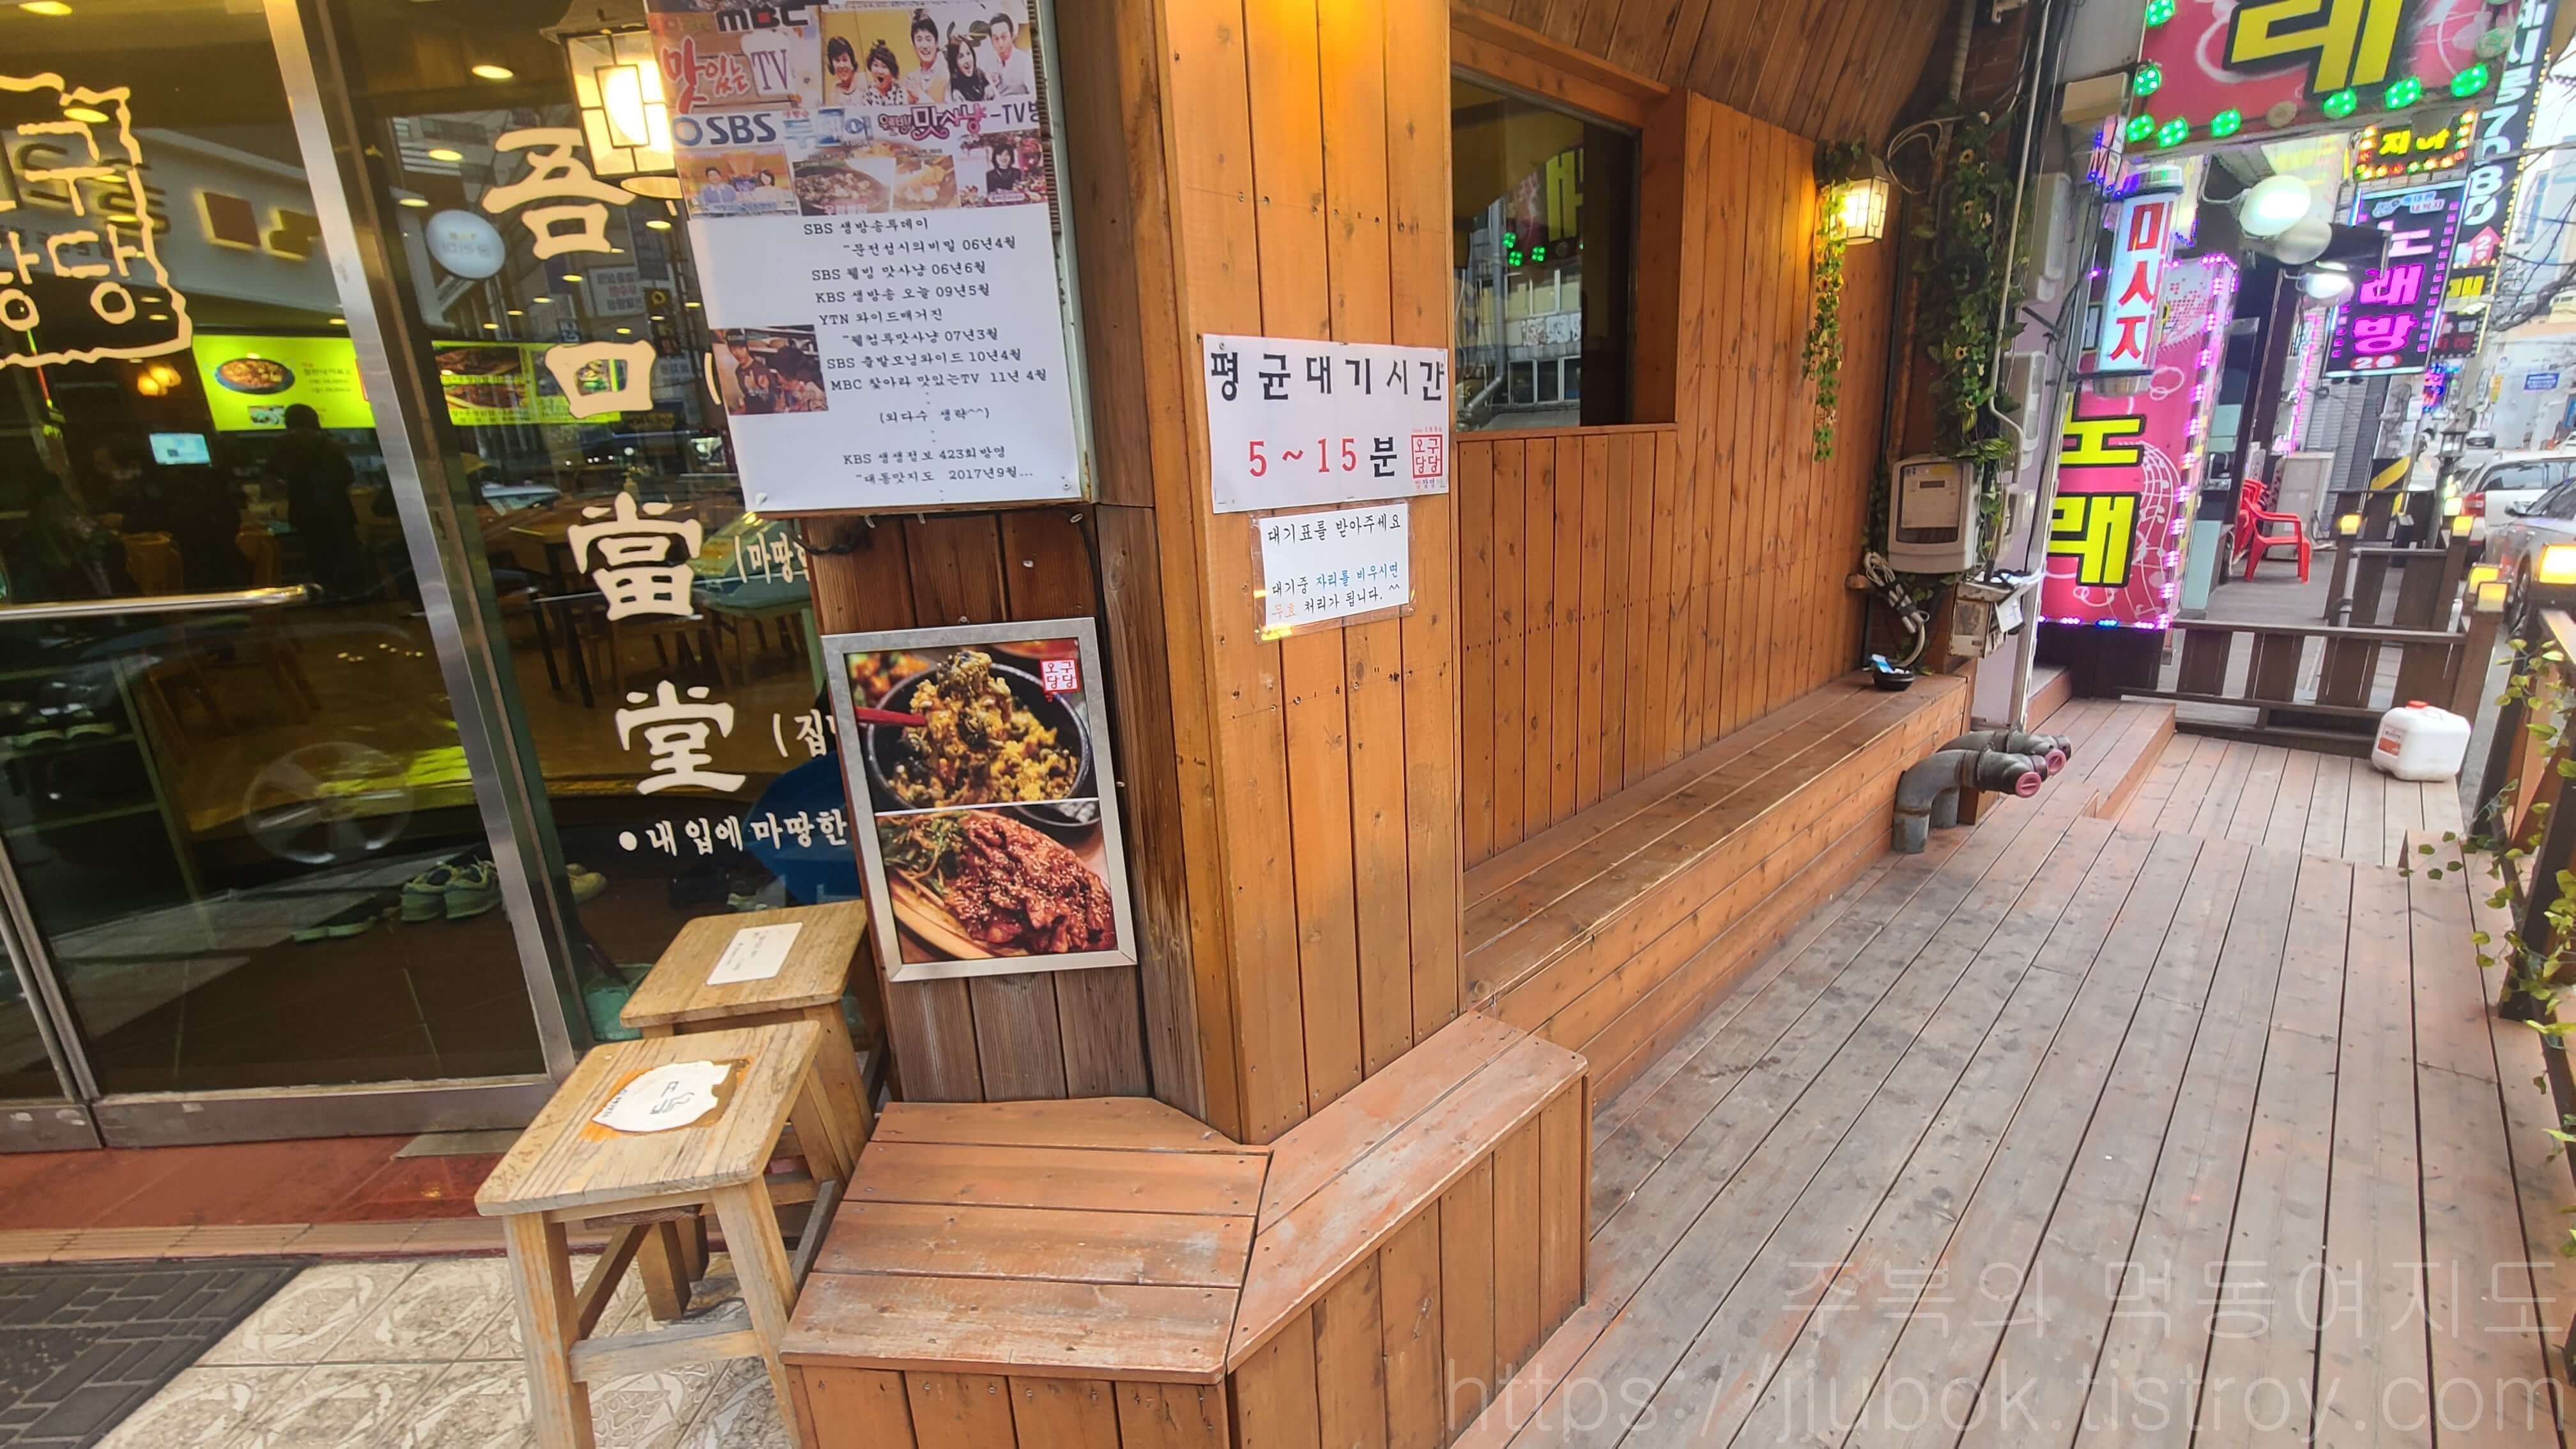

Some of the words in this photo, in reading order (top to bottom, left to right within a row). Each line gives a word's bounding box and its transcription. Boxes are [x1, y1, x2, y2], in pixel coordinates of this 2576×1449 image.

[715, 5, 809, 31] MBC
[663, 37, 749, 114] 맛있는
[751, 49, 788, 90] TV
[706, 113, 777, 145] SBS
[910, 102, 987, 141] 맛사냥
[803, 223, 833, 235] SBS
[840, 217, 928, 234] 생방송투데이
[962, 235, 1015, 250] 06년4월
[811, 269, 841, 281] SBS
[847, 266, 873, 280] 웰빙
[882, 263, 926, 278] 맛사냥
[931, 261, 985, 275] 06년6월
[815, 291, 845, 303] KBS
[852, 288, 894, 303] 생방송
[901, 286, 930, 299] 오늘
[936, 283, 990, 298] 09년5월
[818, 314, 848, 325] YTN
[856, 308, 942, 324] 와이드매거진
[944, 327, 997, 342] 07년3월
[827, 358, 855, 369] SBS
[861, 352, 964, 368] 출발모닝와이드
[969, 348, 1021, 362] 10년4월
[830, 379, 862, 391] MBC
[869, 376, 912, 390] 찾아라
[916, 373, 979, 387] 맛있는TV
[990, 370, 1019, 383] 11년
[1026, 368, 1046, 381] 4월
[1211, 351, 1445, 401] 평균대기시간
[843, 454, 871, 464] KBS
[878, 450, 933, 464] 생생정보
[939, 446, 1004, 459] 423회방영
[1414, 438, 1439, 454] 오구
[1416, 456, 1441, 474] 당당
[1268, 520, 1327, 544] 대기표를
[1335, 514, 1401, 538] 받아주세요
[1272, 576, 1308, 596] 대기중
[1315, 569, 1349, 588] 자리를
[1356, 562, 1399, 581] 비우시면
[1271, 604, 1297, 617] 무효
[1304, 594, 1340, 614] 처리가
[1346, 586, 1383, 608] 됩니다.
[1045, 661, 1073, 673] 오구
[1047, 675, 1075, 689] 당당
[751, 808, 848, 850] 마땅한
